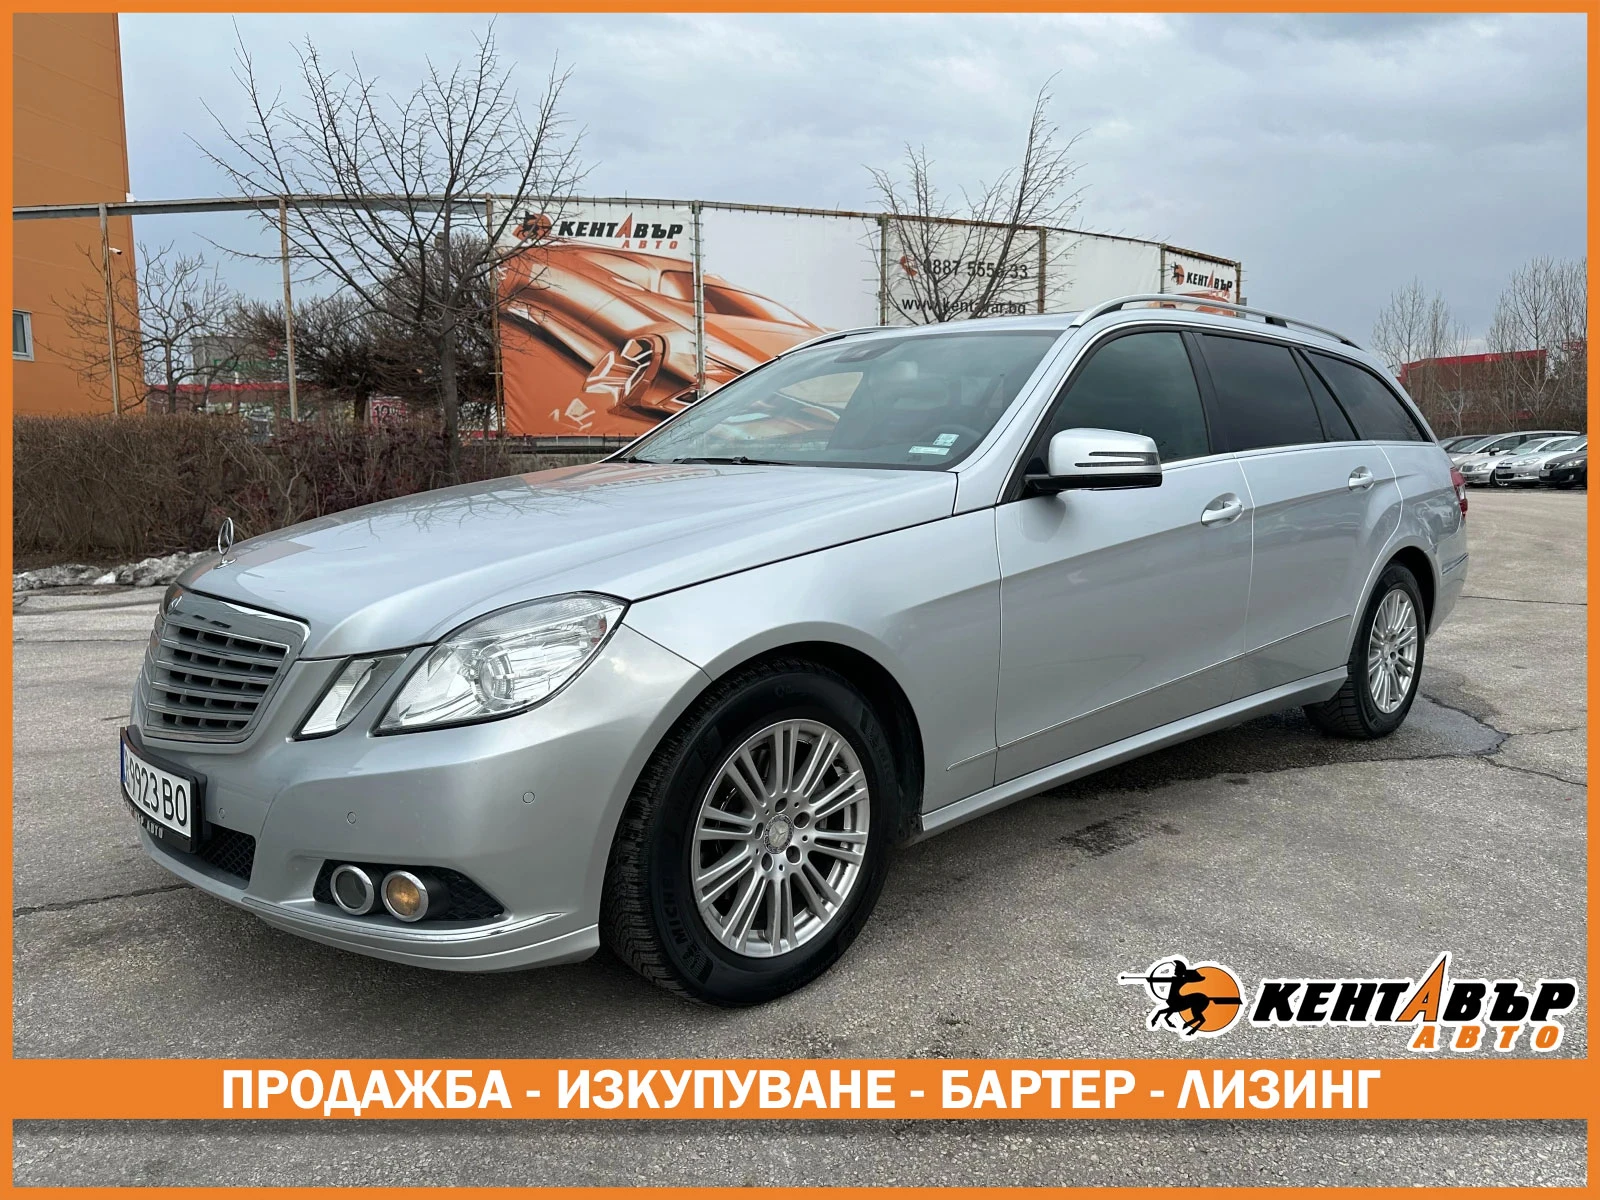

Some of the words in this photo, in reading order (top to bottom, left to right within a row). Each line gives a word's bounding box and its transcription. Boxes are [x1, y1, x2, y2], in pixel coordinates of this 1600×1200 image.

[558, 212, 683, 239] КЕНТАВЪР
[622, 240, 678, 249] АВТО
[1186, 270, 1233, 292] КЕНТАВЪР
